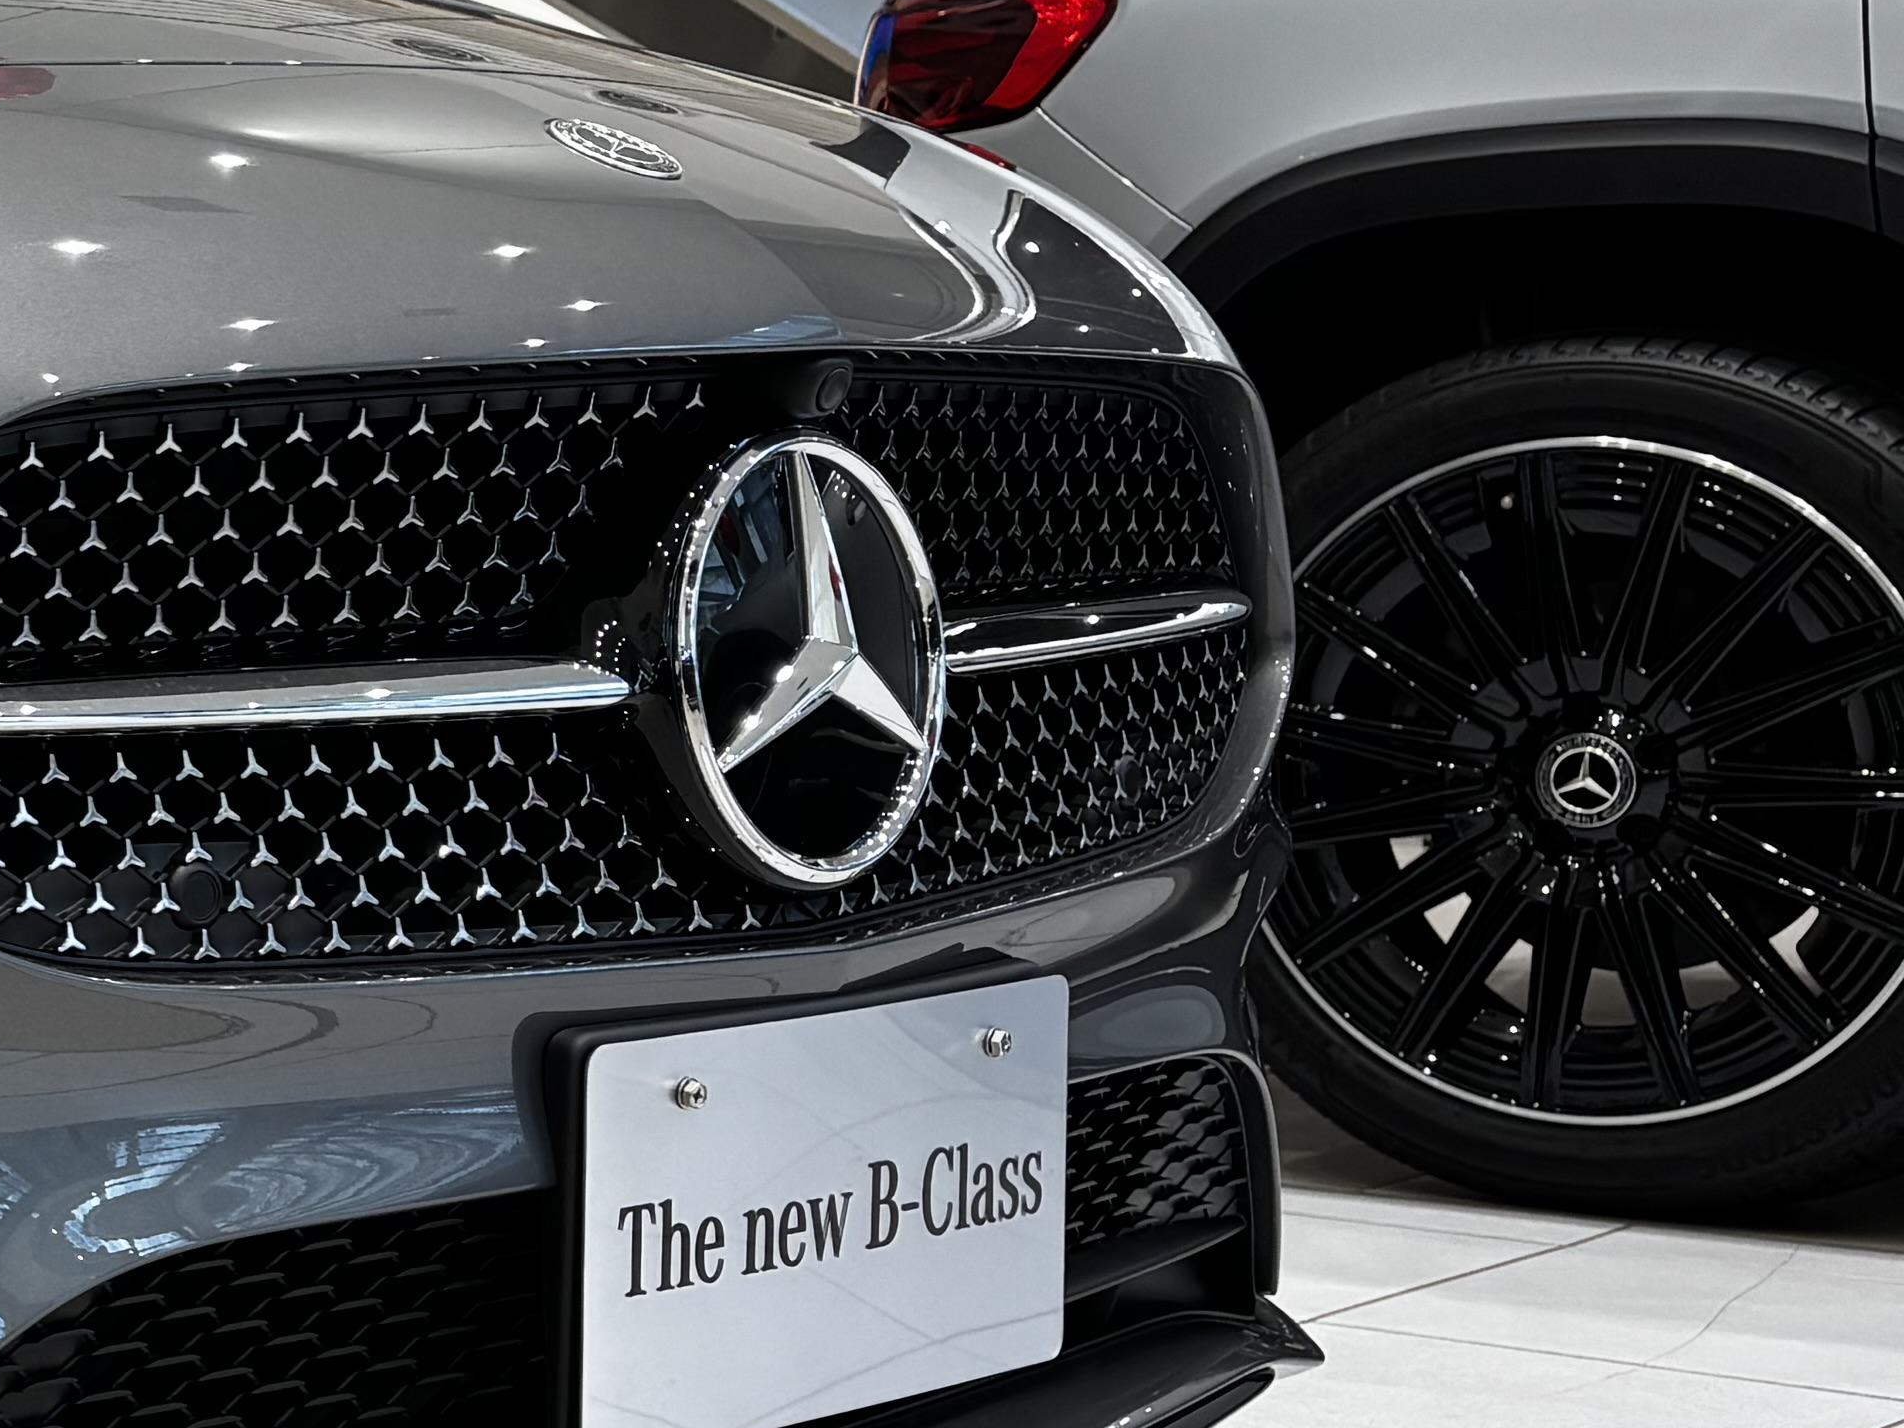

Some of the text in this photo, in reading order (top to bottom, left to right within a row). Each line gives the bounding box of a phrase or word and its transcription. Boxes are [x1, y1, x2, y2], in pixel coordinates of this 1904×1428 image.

[617, 1142, 1043, 1298] The new B-Class
